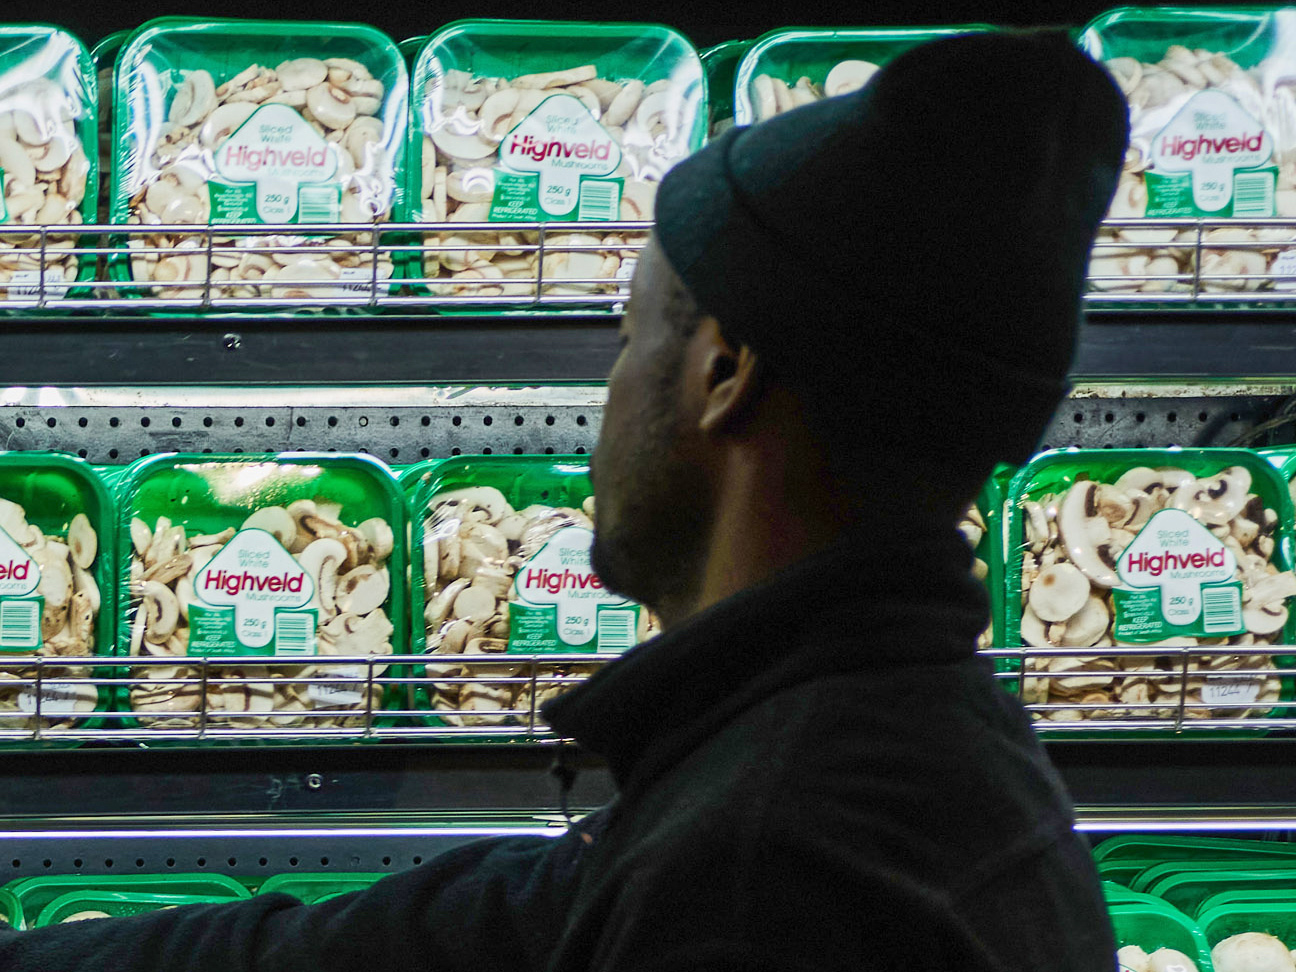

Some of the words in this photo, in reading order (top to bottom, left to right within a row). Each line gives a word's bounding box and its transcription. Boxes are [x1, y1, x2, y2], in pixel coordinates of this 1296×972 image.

[1161, 131, 1264, 160] Highveld
[225, 145, 327, 172] Highveld
[547, 186, 564, 194] 250
[1158, 537, 1189, 547] White
[238, 549, 270, 559] Sliced
[239, 559, 269, 568] White
[1128, 547, 1225, 576] Highveld
[1170, 569, 1226, 579] Mushrooms
[205, 570, 304, 595] Highveld
[1169, 596, 1186, 604] 250
[243, 618, 259, 626] 250
[565, 616, 581, 624] 250
